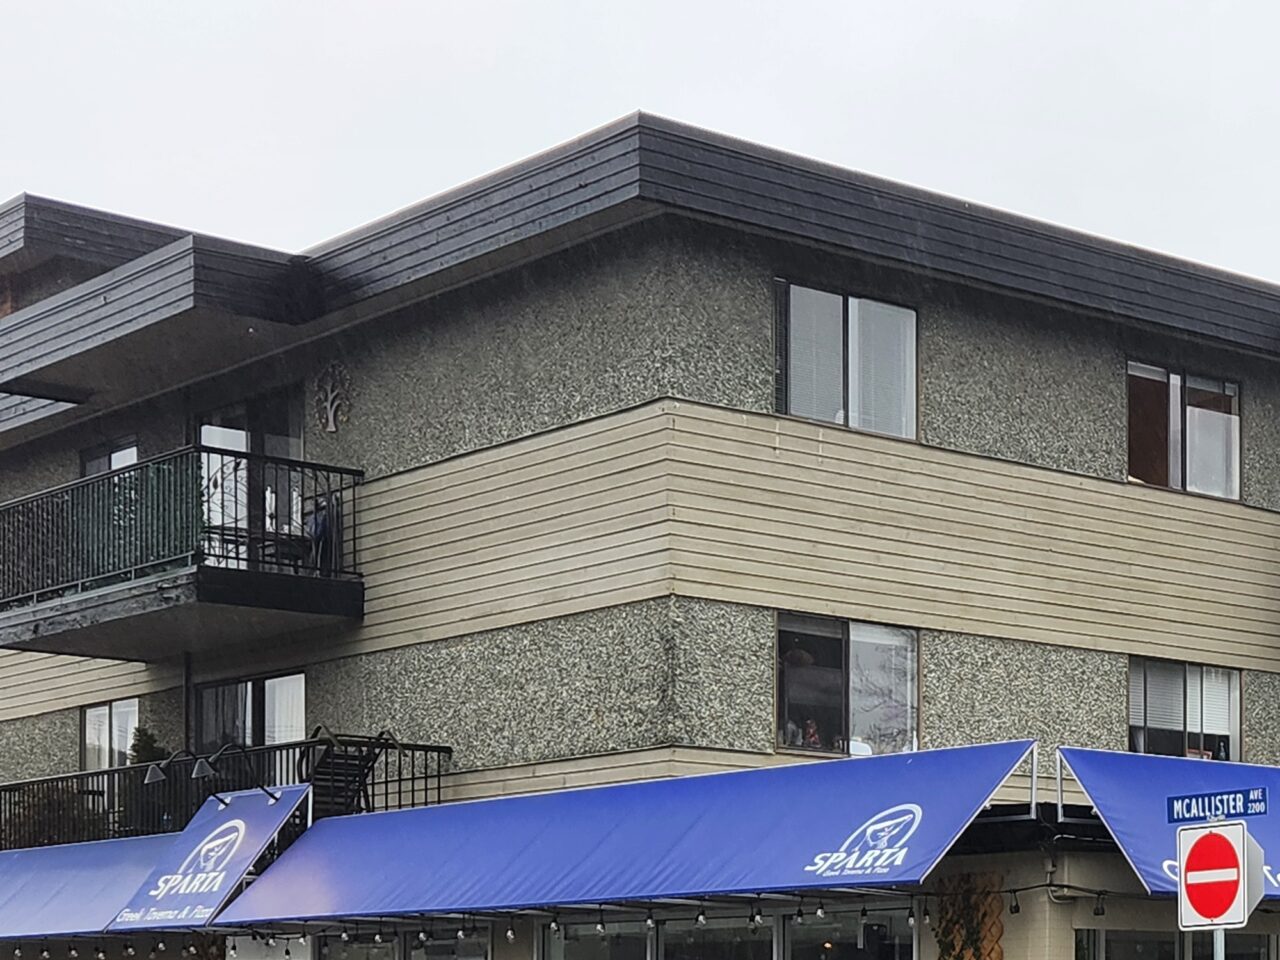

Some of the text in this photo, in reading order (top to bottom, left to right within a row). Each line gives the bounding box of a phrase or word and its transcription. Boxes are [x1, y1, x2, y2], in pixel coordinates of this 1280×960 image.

[1173, 793, 1244, 819] MCALLISTER
[1249, 788, 1263, 800] AVE
[1247, 802, 1265, 814] 2200
[804, 847, 908, 875] SPARTA
[148, 871, 226, 900] SPARTA
